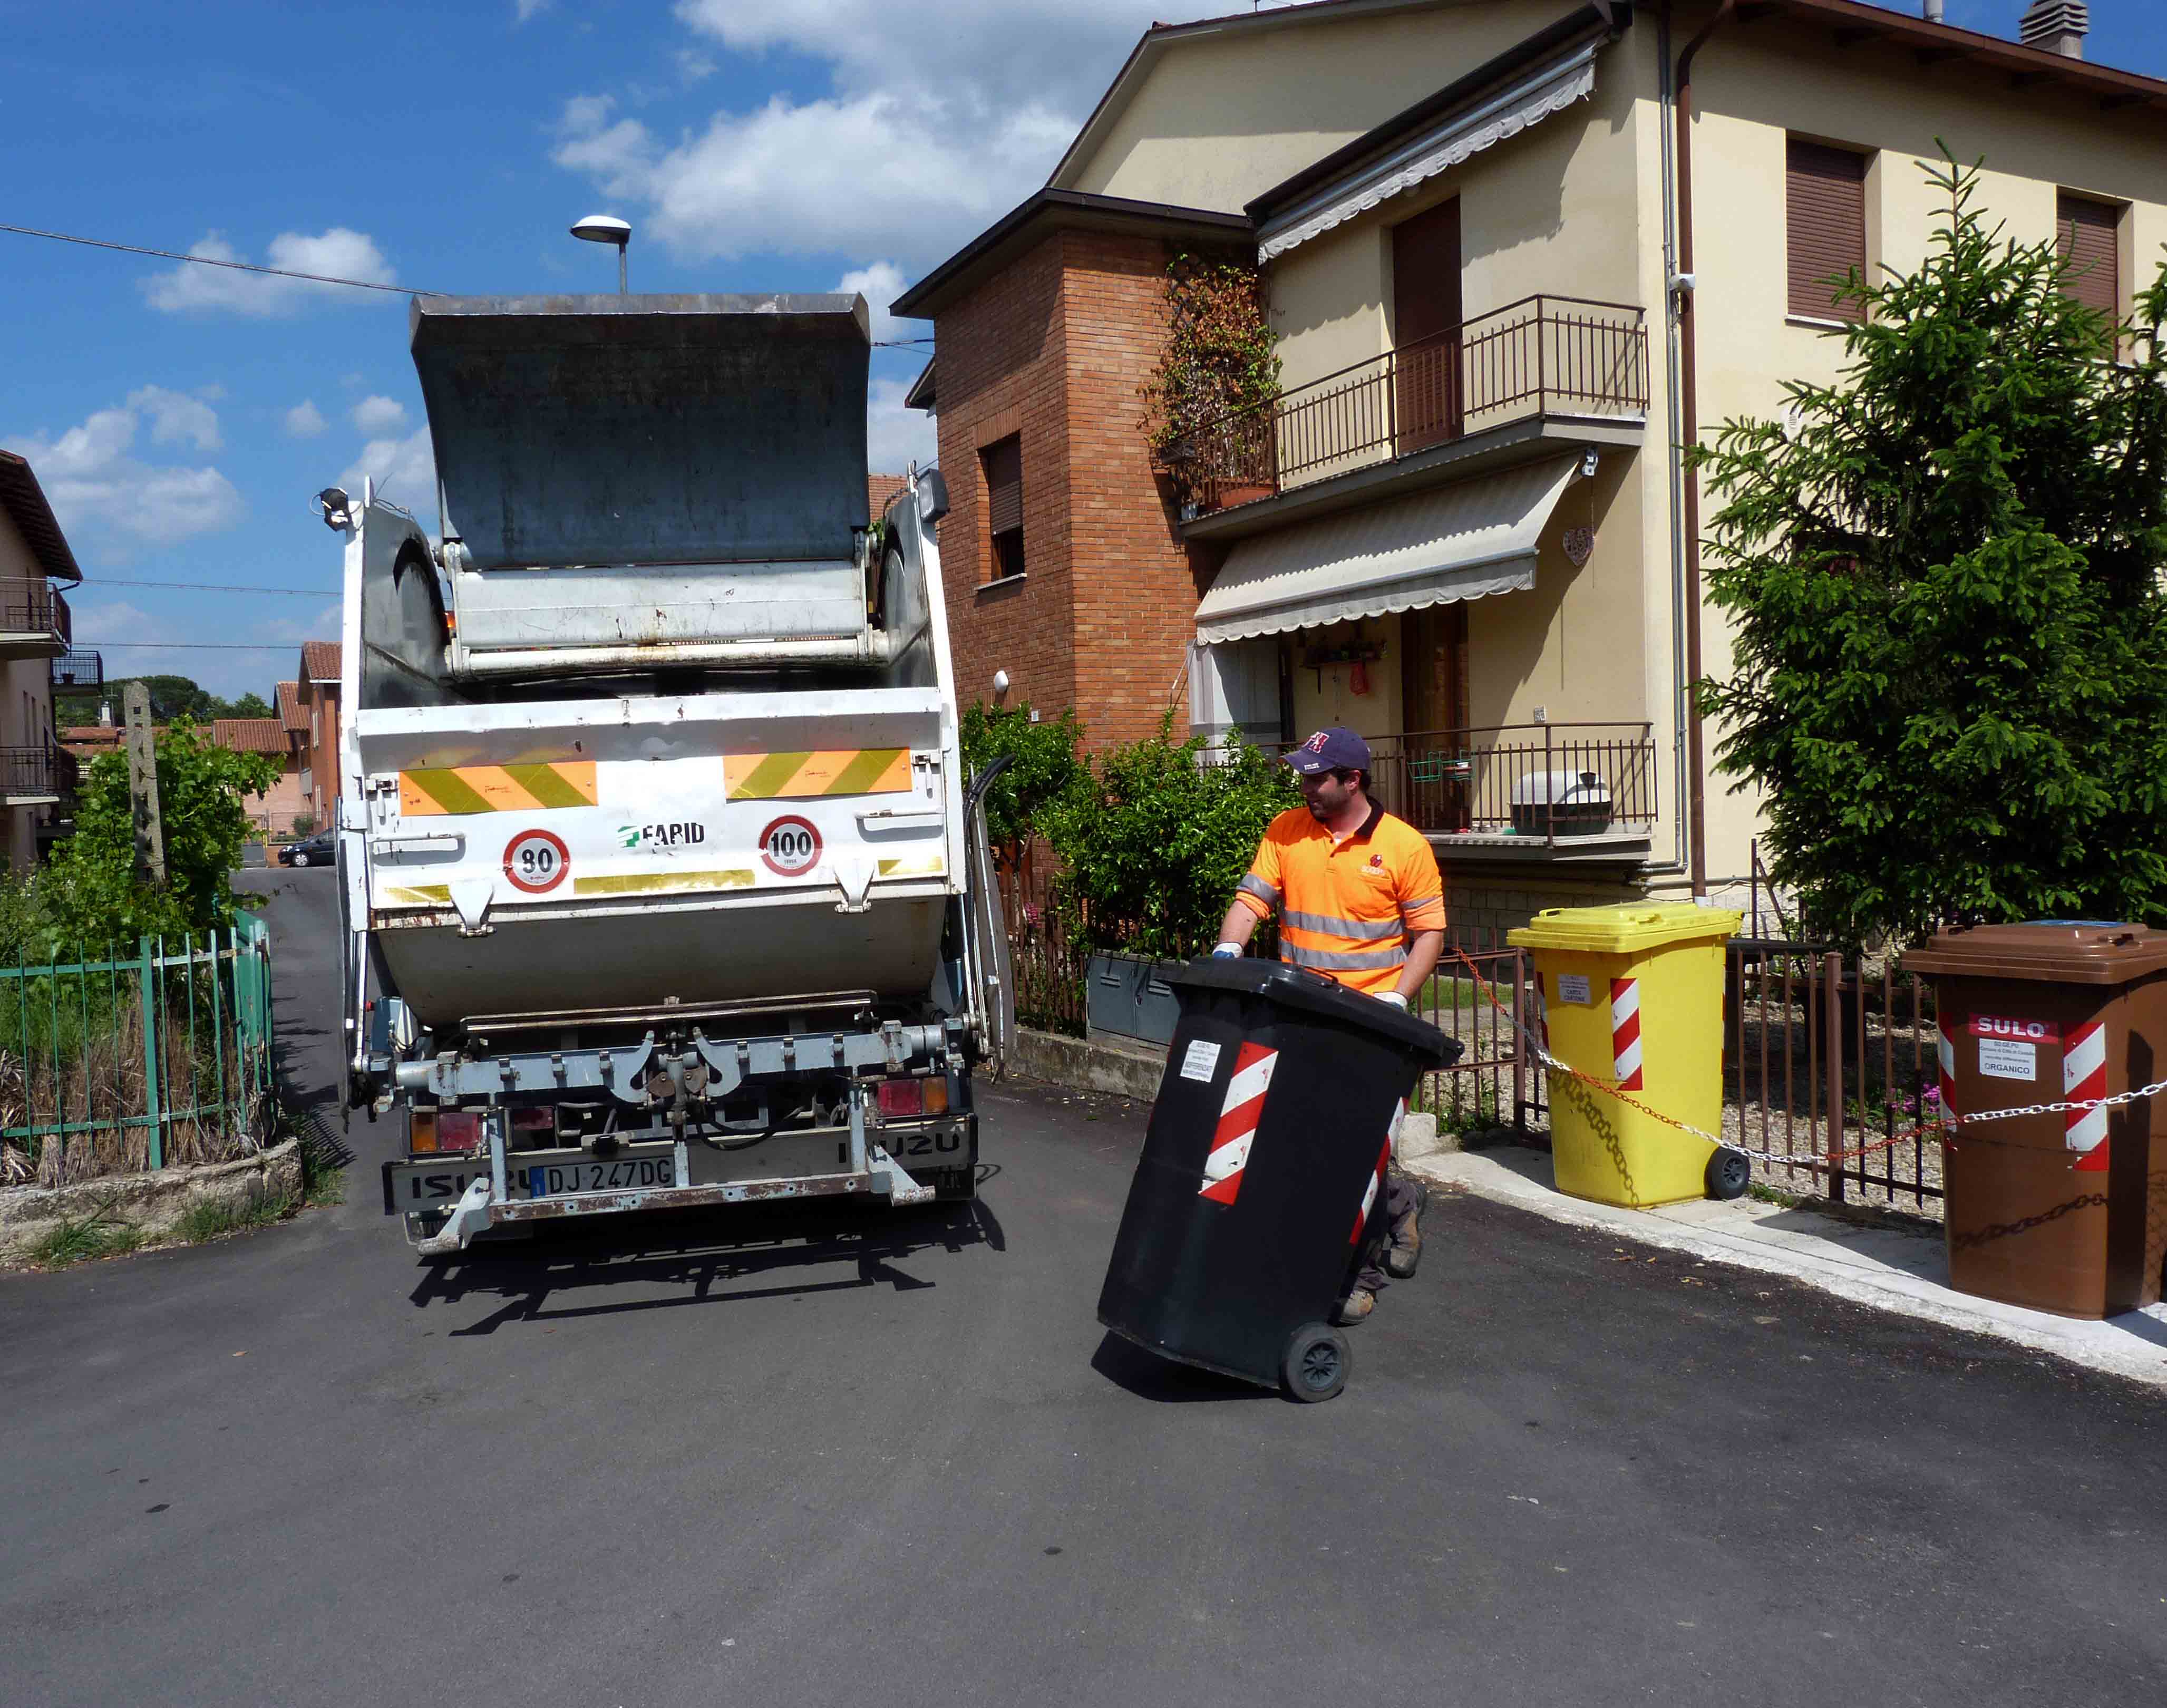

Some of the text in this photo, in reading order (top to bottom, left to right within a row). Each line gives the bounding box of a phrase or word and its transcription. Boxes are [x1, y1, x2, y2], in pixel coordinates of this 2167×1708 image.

[643, 822, 705, 846] FARID
[771, 831, 812, 857] 100
[521, 847, 553, 874] 80
[1977, 1017, 2045, 1038] SULO
[1985, 1063, 2030, 1074] ORGANICO
[838, 1133, 960, 1163] IUZU
[549, 1166, 580, 1193] DJ
[590, 1159, 671, 1190] 247DG
